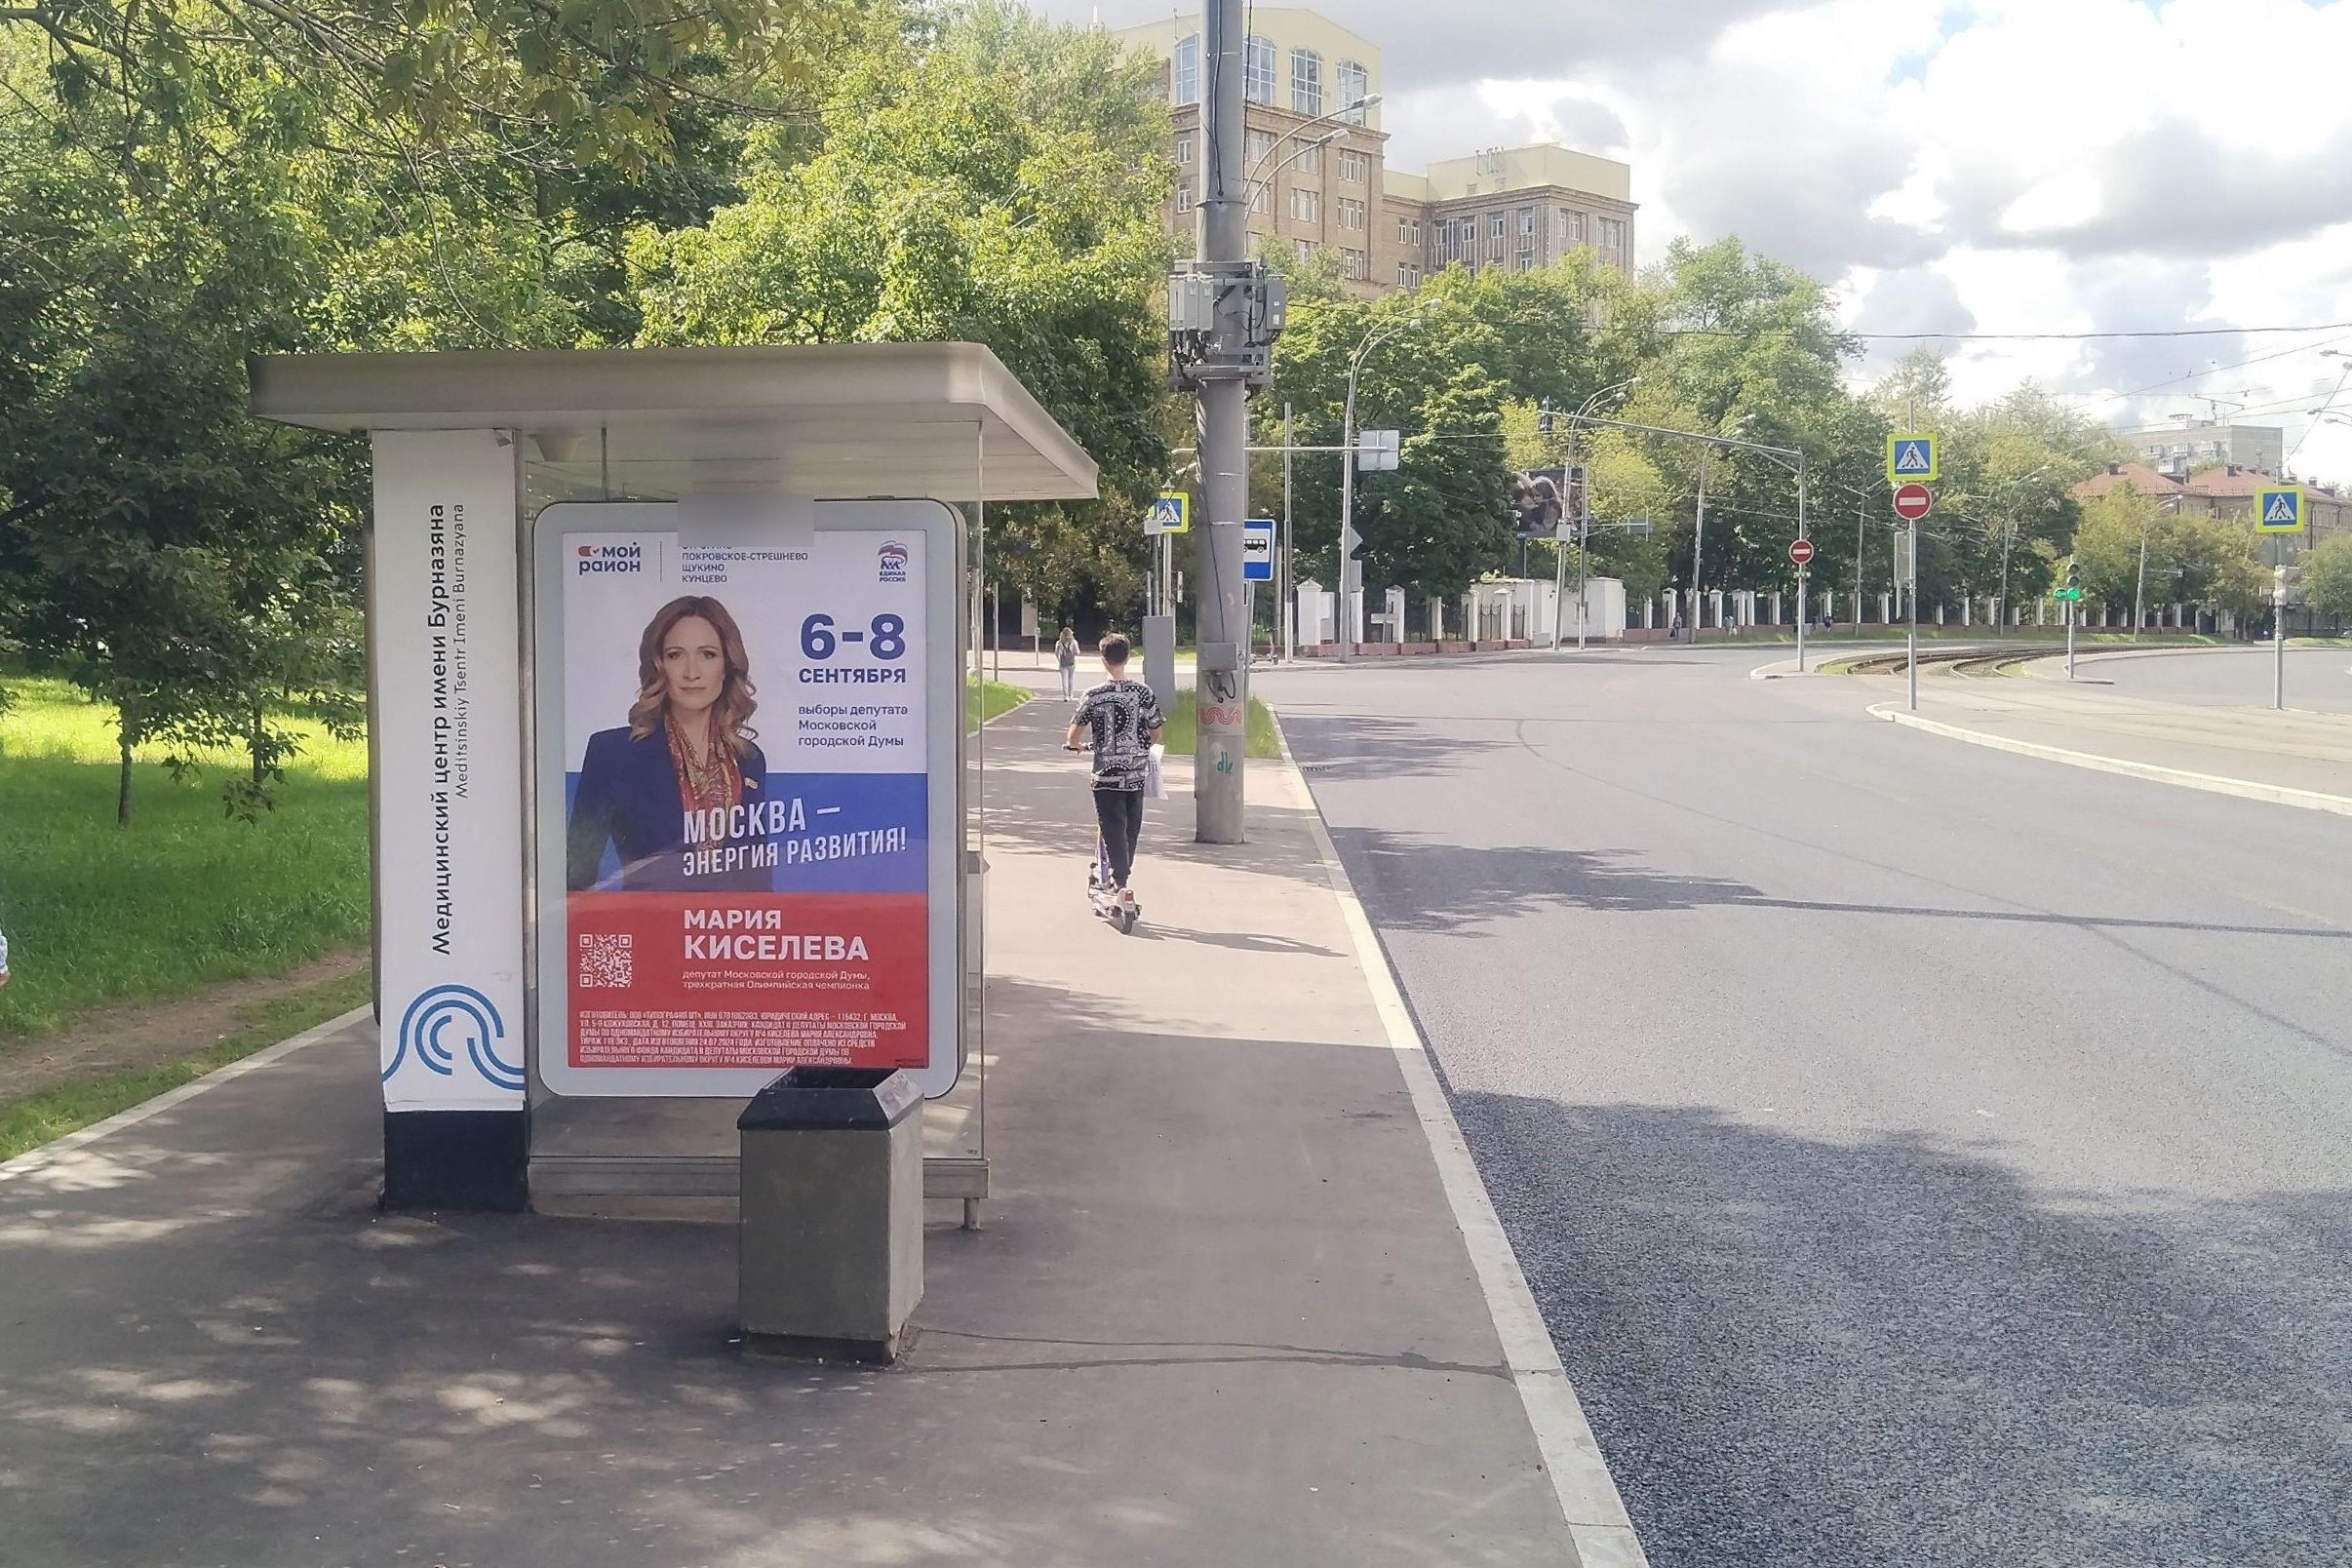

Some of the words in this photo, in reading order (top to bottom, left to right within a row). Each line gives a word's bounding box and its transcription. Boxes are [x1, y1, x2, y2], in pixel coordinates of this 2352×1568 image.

[452, 504, 468, 593] Burnazyana
[682, 552, 808, 561] ПОКРОВСКОЕ-СТРЕШНЕВО
[427, 504, 450, 628] Бурназяна
[682, 564, 725, 572] ЩУКИНО
[682, 574, 727, 583] КУНЦЕВО
[452, 598, 466, 644] Imeni
[432, 635, 448, 709] имени
[453, 647, 467, 694] Tsentr
[799, 668, 906, 684] СЕНТЯБРЯ
[799, 704, 847, 717] выборы
[850, 706, 908, 717] депутата
[799, 720, 877, 730] Московской
[434, 716, 451, 783] центр
[454, 697, 470, 799] Meditsinskiy
[799, 735, 865, 747] городской
[868, 736, 904, 749] Думы
[684, 798, 806, 844] МОСКВА
[683, 842, 778, 877] ЭНЕРГИЯ
[787, 826, 907, 865] РАЗВИТИЯ!
[430, 792, 453, 956] Медицинский
[684, 909, 781, 929] МАРИЯ
[685, 935, 870, 960] КИСЕЛЕВА
[724, 970, 784, 979] Московской
[786, 971, 839, 980] городской
[747, 981, 814, 990] Олимпийская
